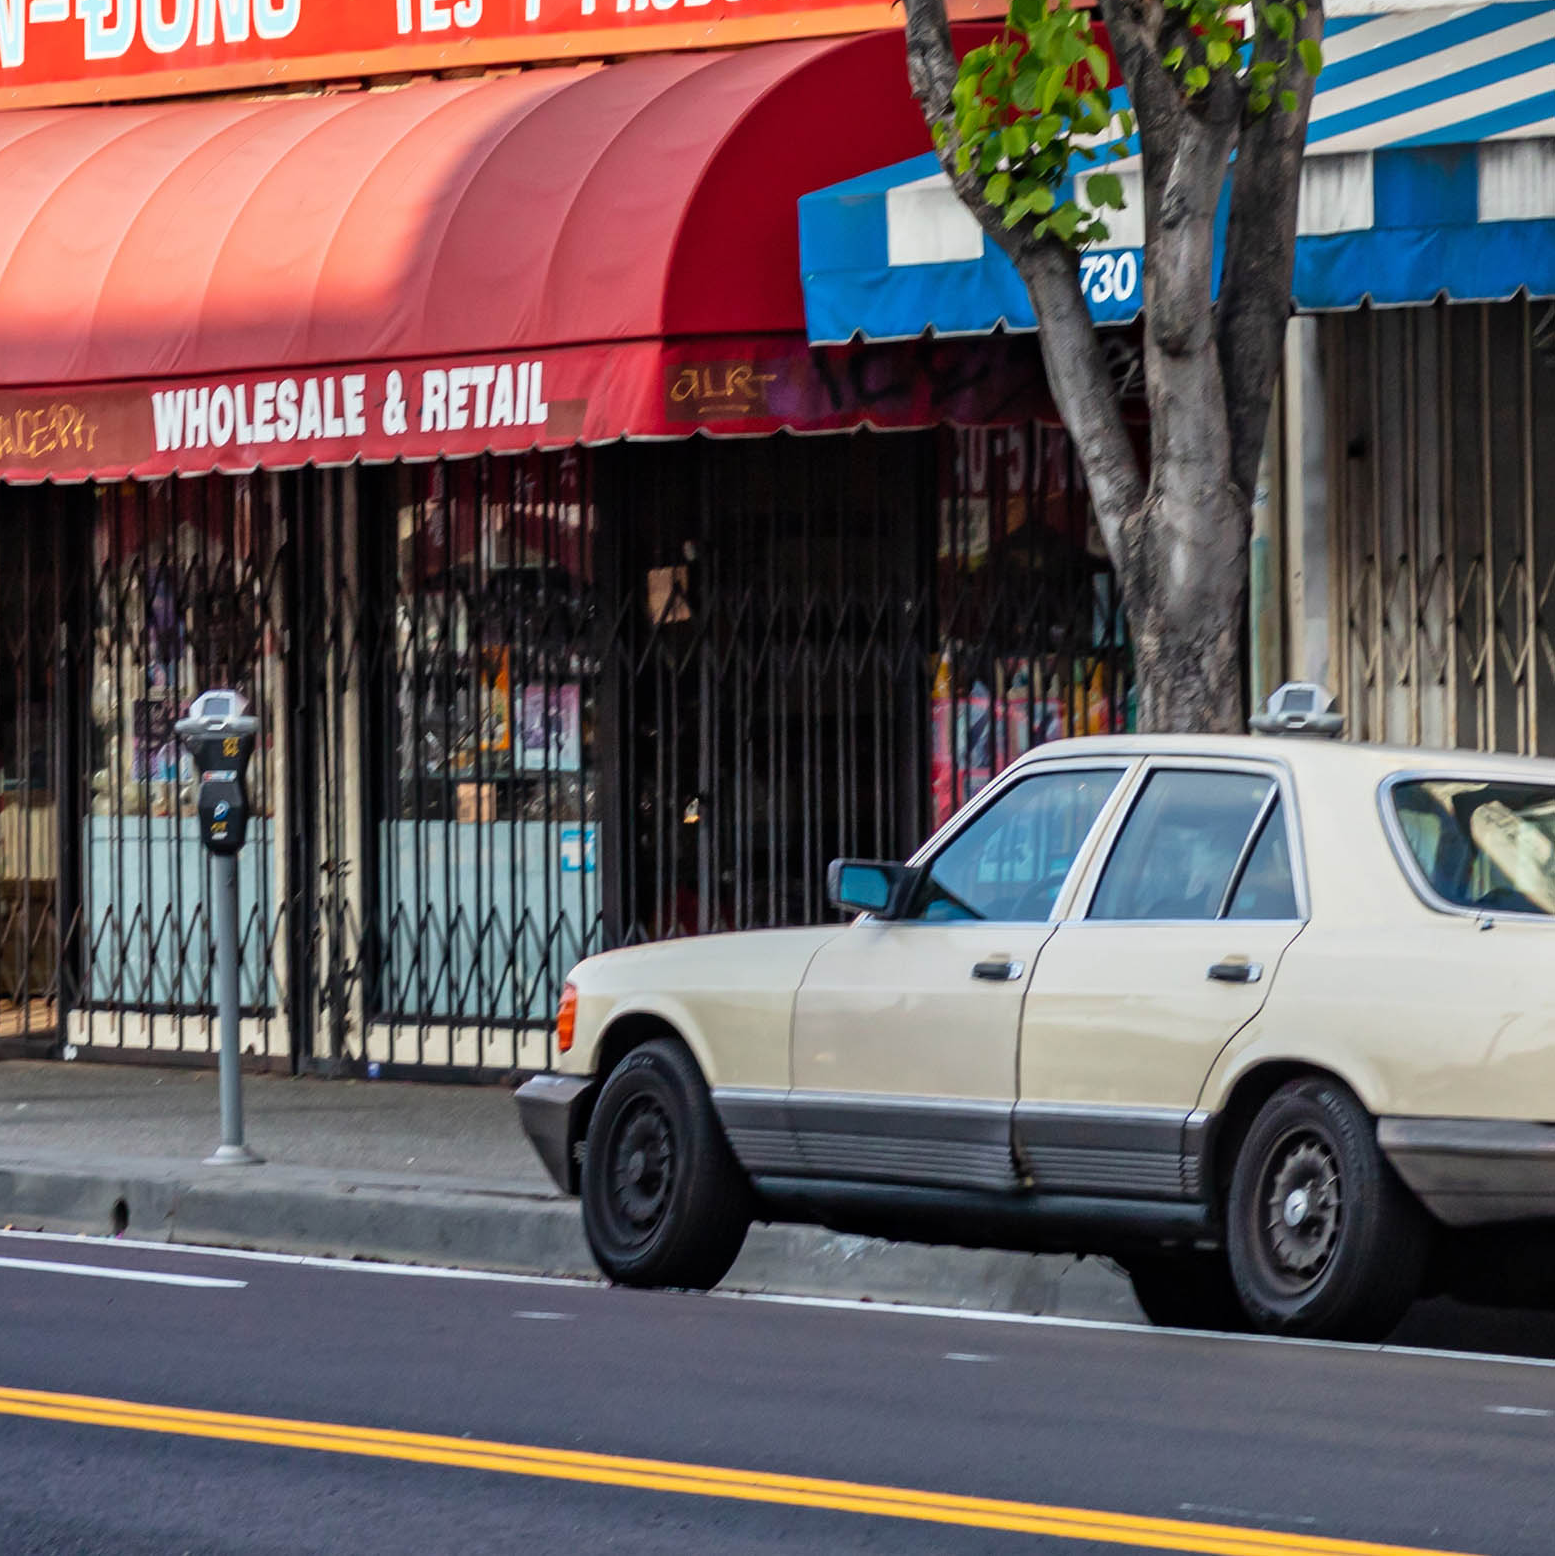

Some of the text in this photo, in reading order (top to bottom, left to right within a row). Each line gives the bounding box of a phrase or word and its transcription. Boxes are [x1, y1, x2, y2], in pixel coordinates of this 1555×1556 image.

[1079, 250, 1136, 304] 730
[151, 373, 366, 453] WHOLESALE
[382, 369, 408, 436] &
[420, 360, 549, 433] RETAIL
